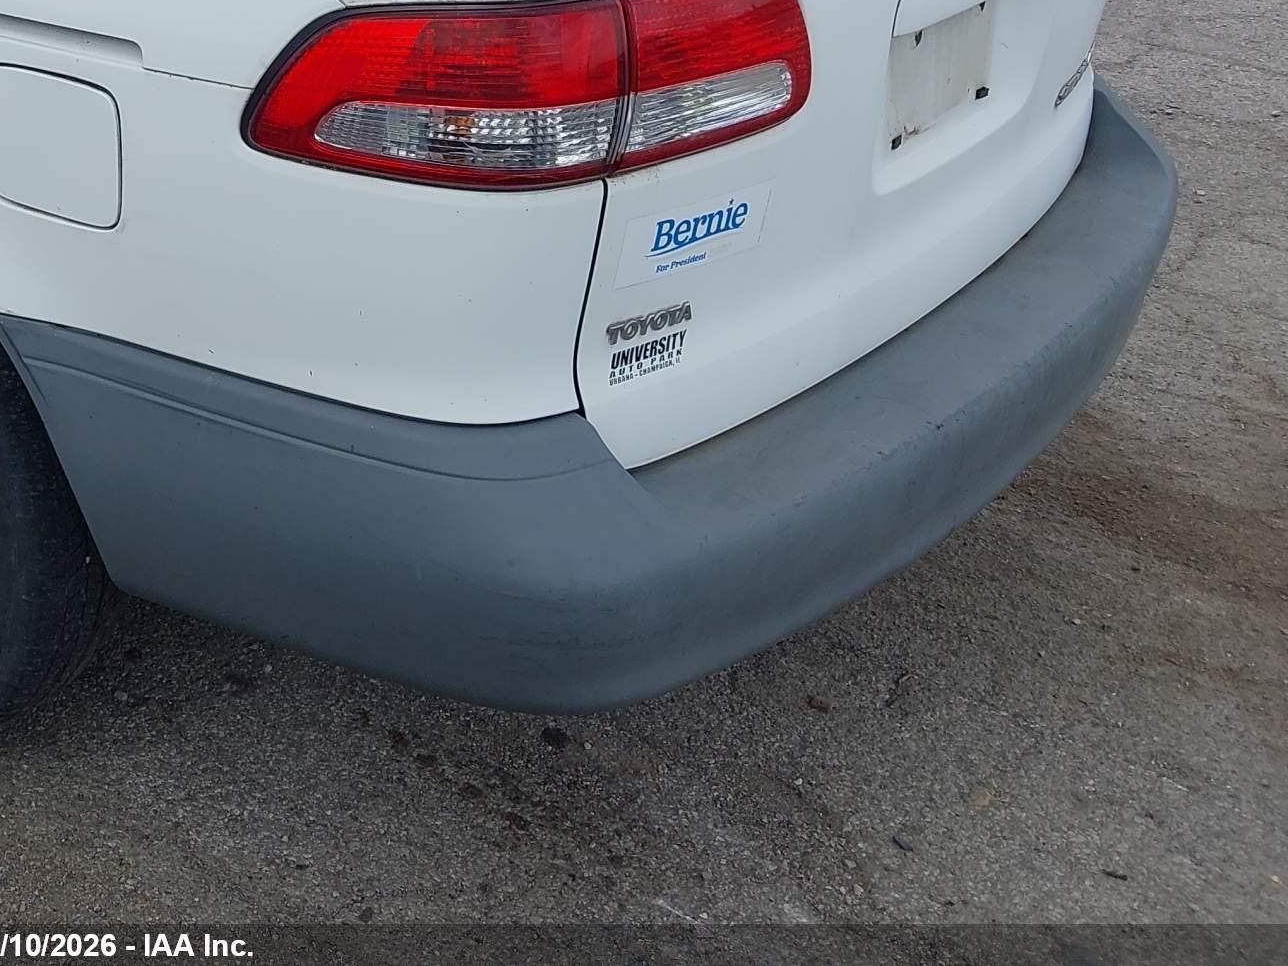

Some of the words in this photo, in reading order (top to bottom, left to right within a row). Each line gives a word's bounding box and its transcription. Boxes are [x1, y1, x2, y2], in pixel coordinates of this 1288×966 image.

[649, 198, 748, 253] Bernie
[655, 264, 670, 274] For
[670, 252, 707, 270] President
[606, 300, 693, 346] TOYOTA
[609, 362, 643, 379] AUTO
[650, 348, 682, 366] PARK
[610, 329, 687, 370] UNIVERSITY
